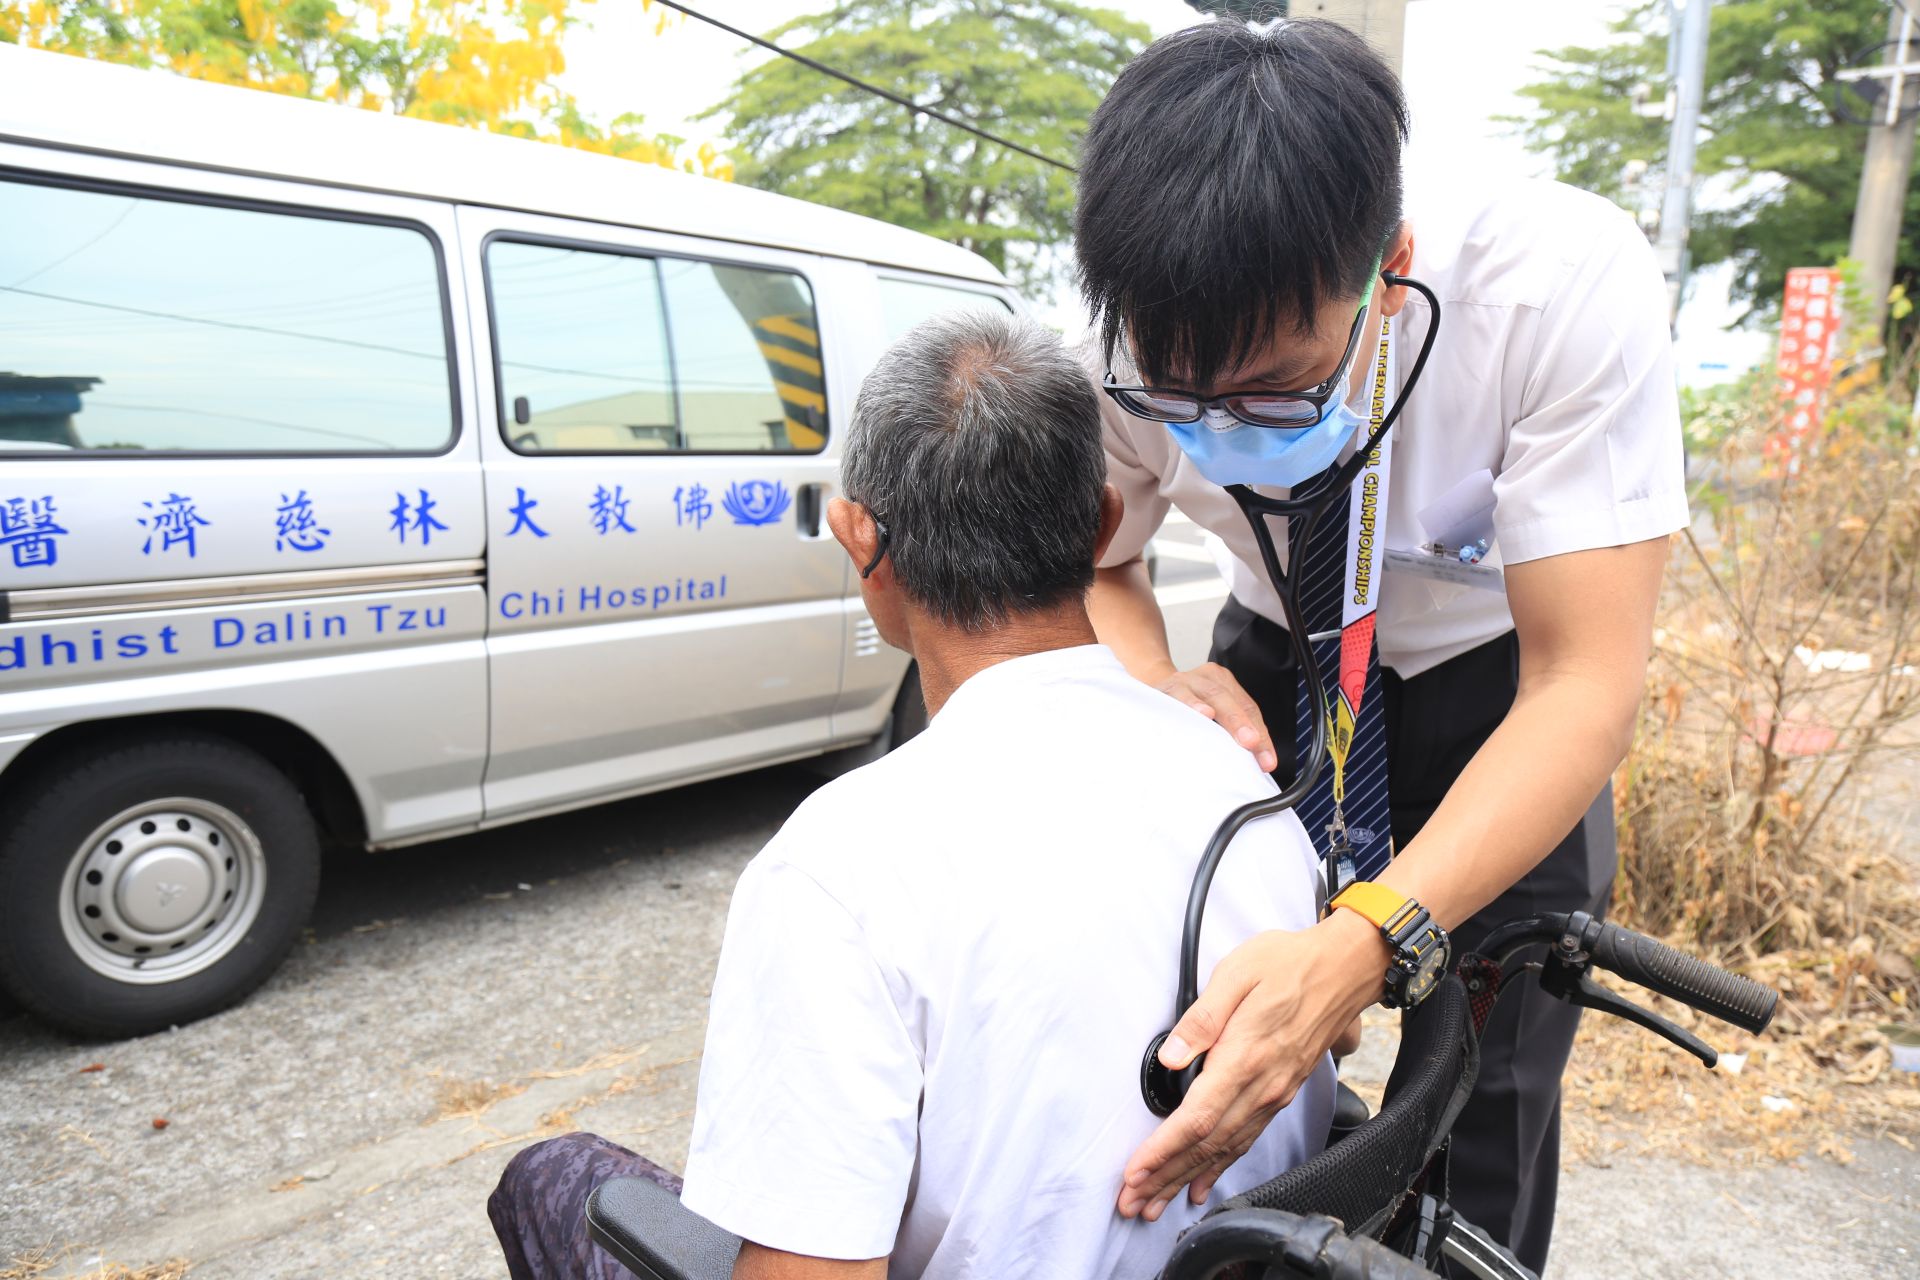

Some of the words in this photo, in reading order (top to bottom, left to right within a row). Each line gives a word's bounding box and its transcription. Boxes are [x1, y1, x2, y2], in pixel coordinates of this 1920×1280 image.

[1354, 472, 1379, 605] CHAMPIONSHIPS
[213, 611, 346, 649] Dalin
[368, 604, 446, 634] Tzu
[500, 591, 564, 619] Chi
[579, 576, 727, 610] Hospital
